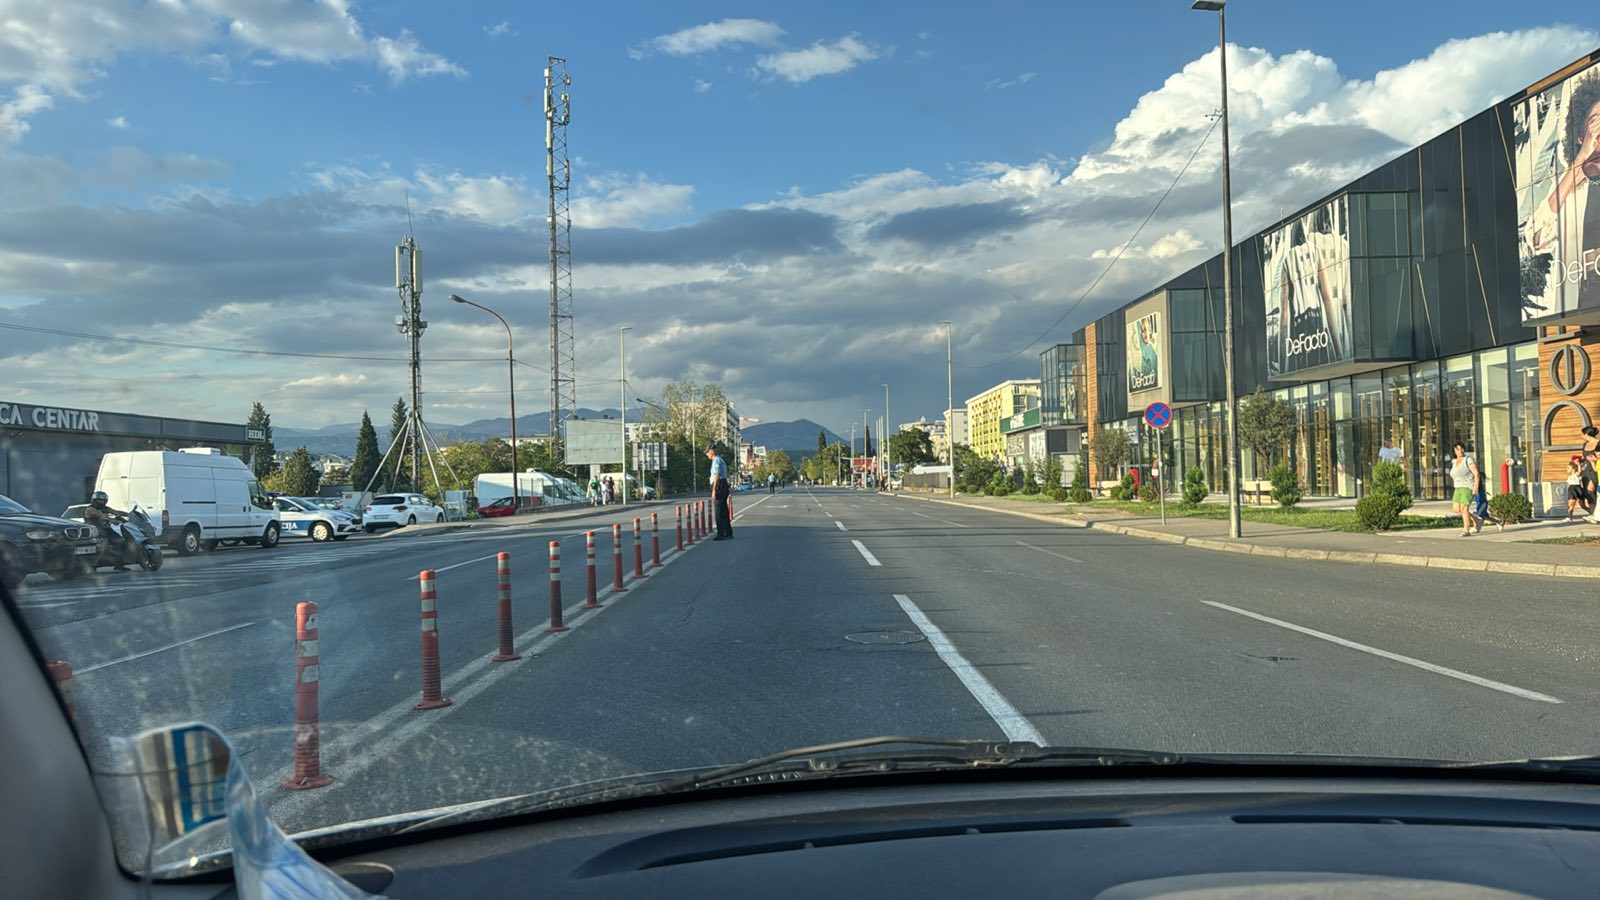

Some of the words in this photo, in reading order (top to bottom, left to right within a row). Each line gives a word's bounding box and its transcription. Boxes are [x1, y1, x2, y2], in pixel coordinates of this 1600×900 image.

[1285, 328, 1328, 357] DeFacto
[1132, 369, 1156, 388] DeFacto
[31, 407, 99, 431] CENTAR
